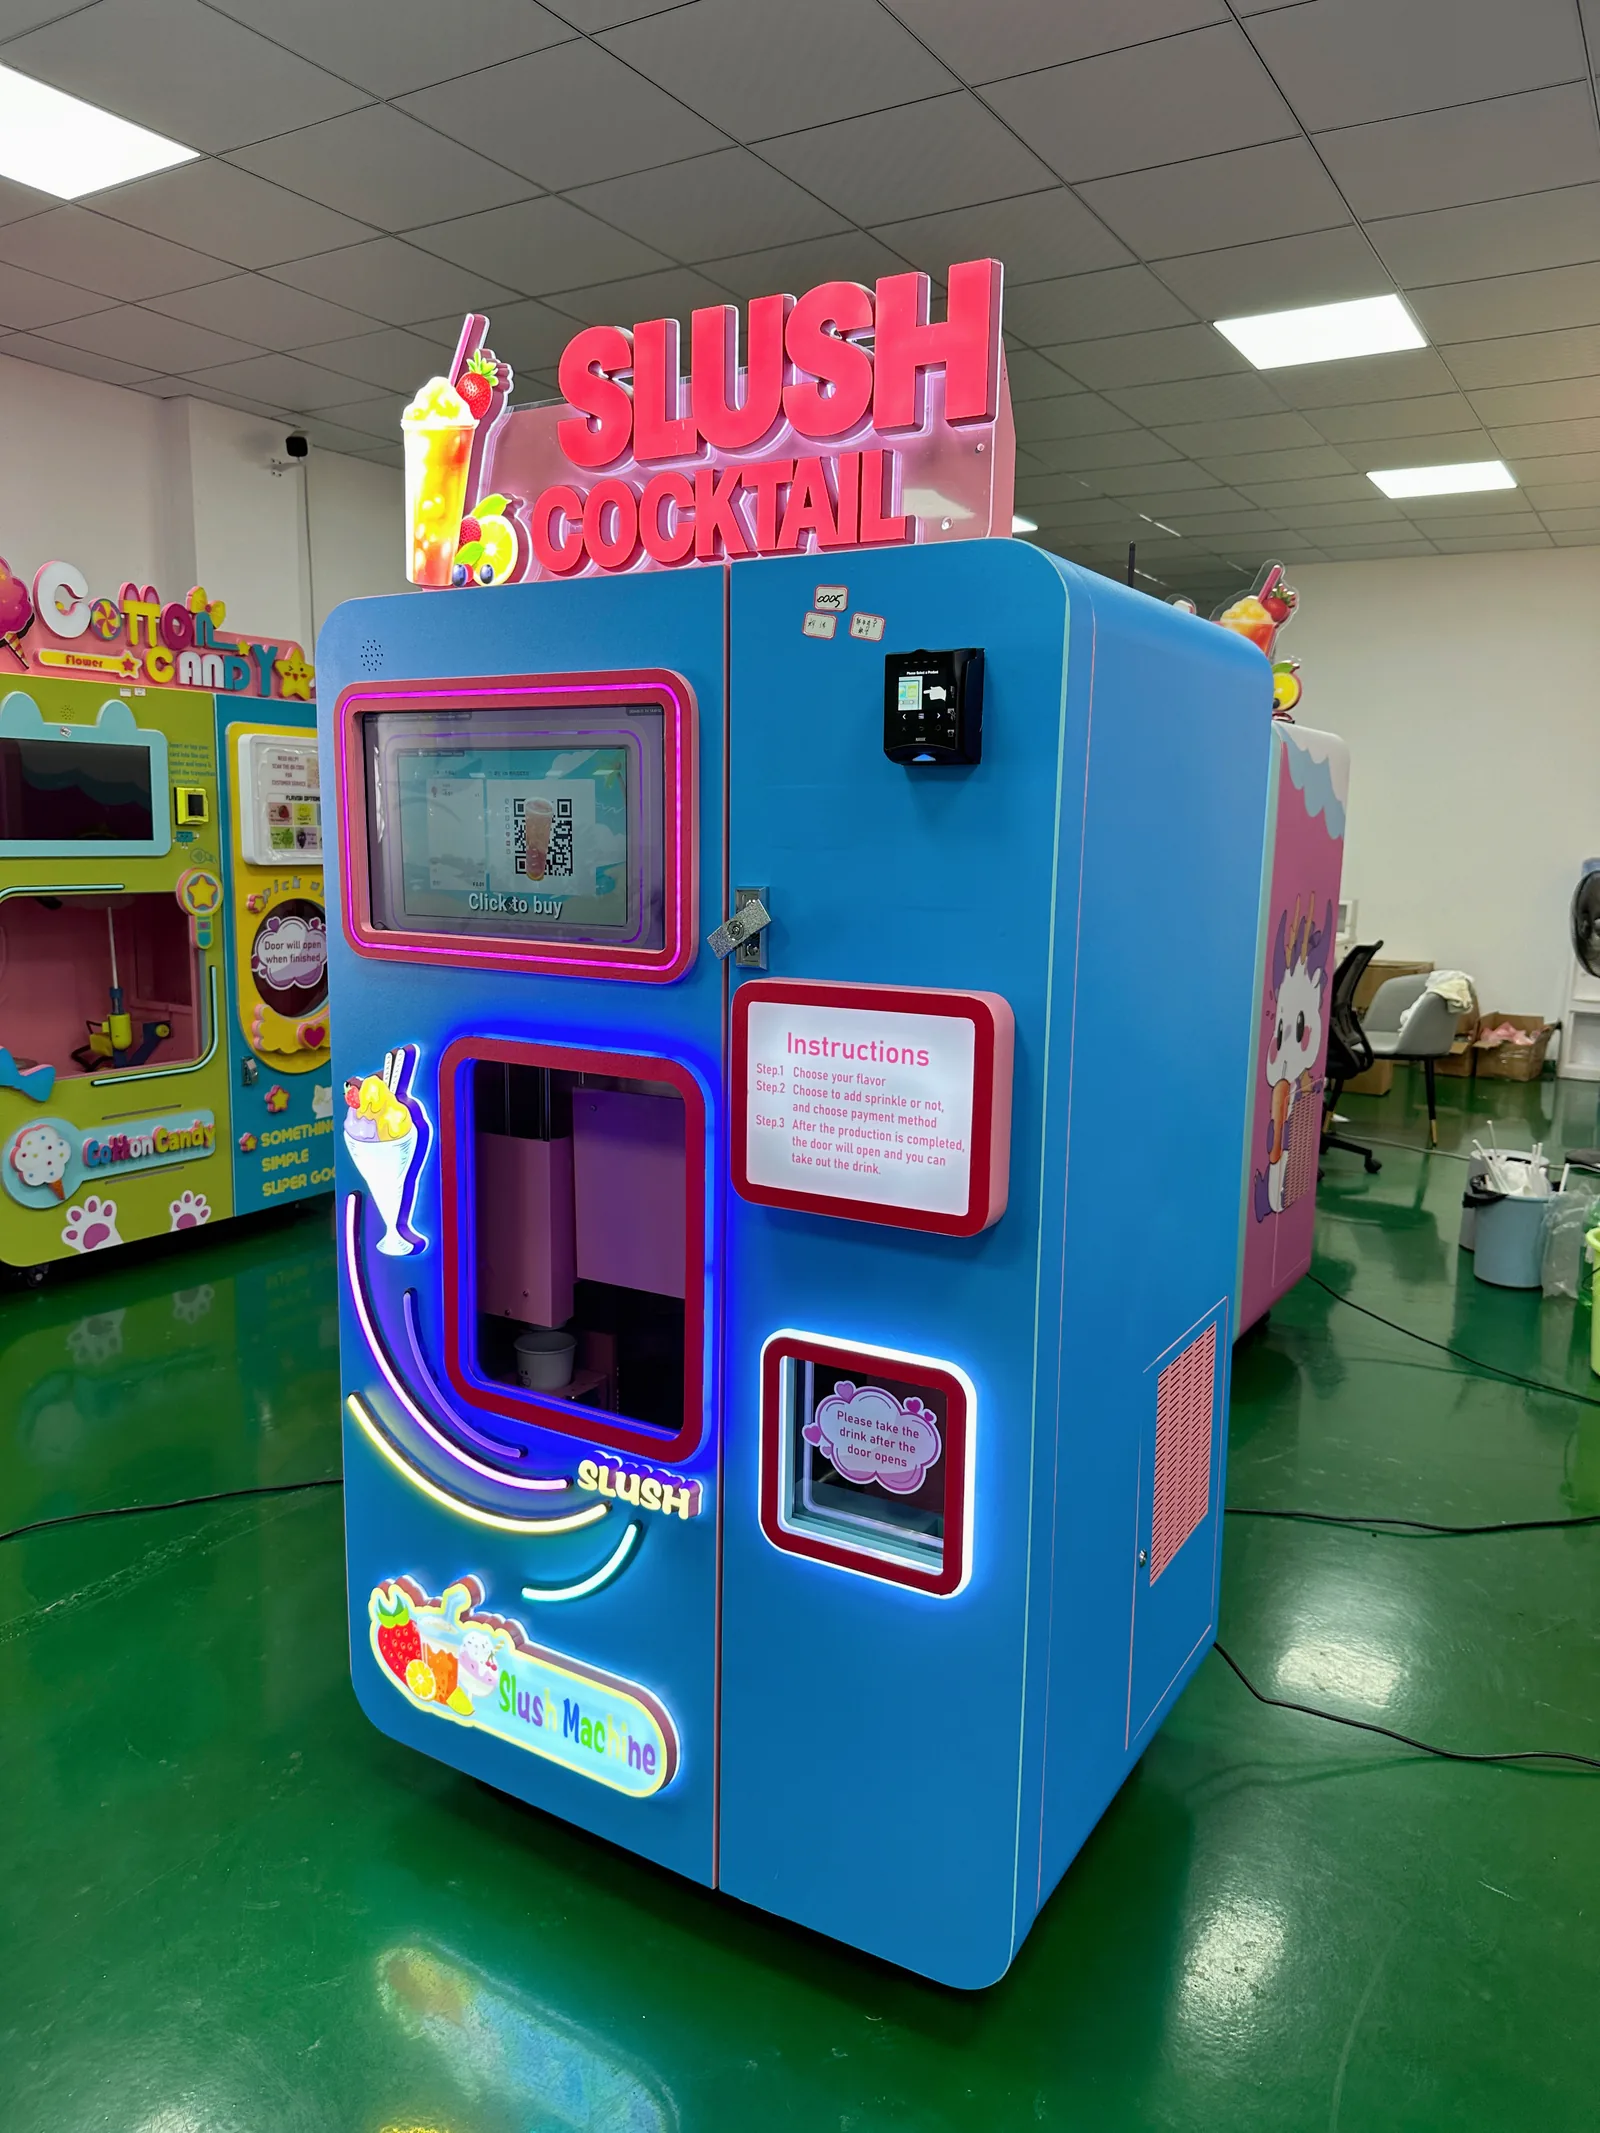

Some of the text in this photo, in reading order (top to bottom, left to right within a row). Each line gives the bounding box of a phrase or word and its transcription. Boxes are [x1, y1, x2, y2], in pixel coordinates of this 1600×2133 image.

[557, 258, 1000, 468] SLUSH
[531, 449, 912, 577] COCKTAIL
[816, 594, 844, 608] 0005
[468, 892, 562, 919] Click to buy
[264, 941, 322, 951] Door will open
[265, 953, 321, 964] when finished
[787, 1032, 930, 1067] Instructions
[756, 1063, 886, 1087] Step.1 Choose your flavor
[756, 1081, 944, 1113] Step.2 Choose to add sprinkle or not,
[792, 1102, 937, 1128] and choose payment method
[261, 1119, 334, 1147] SOMETHIN
[756, 1115, 965, 1153] Step.3 After the production is completed,
[262, 1148, 309, 1172] SIMPLE
[792, 1136, 946, 1166] the door will open and you can
[792, 1153, 881, 1175] take out the drink.
[262, 1173, 307, 1197] SUPER
[837, 1411, 919, 1439] Please take the
[840, 1427, 915, 1454] drink after the
[847, 1444, 907, 1468] door opens
[578, 1456, 696, 1519] SLUSH
[499, 1669, 656, 1776] Slush Machine
